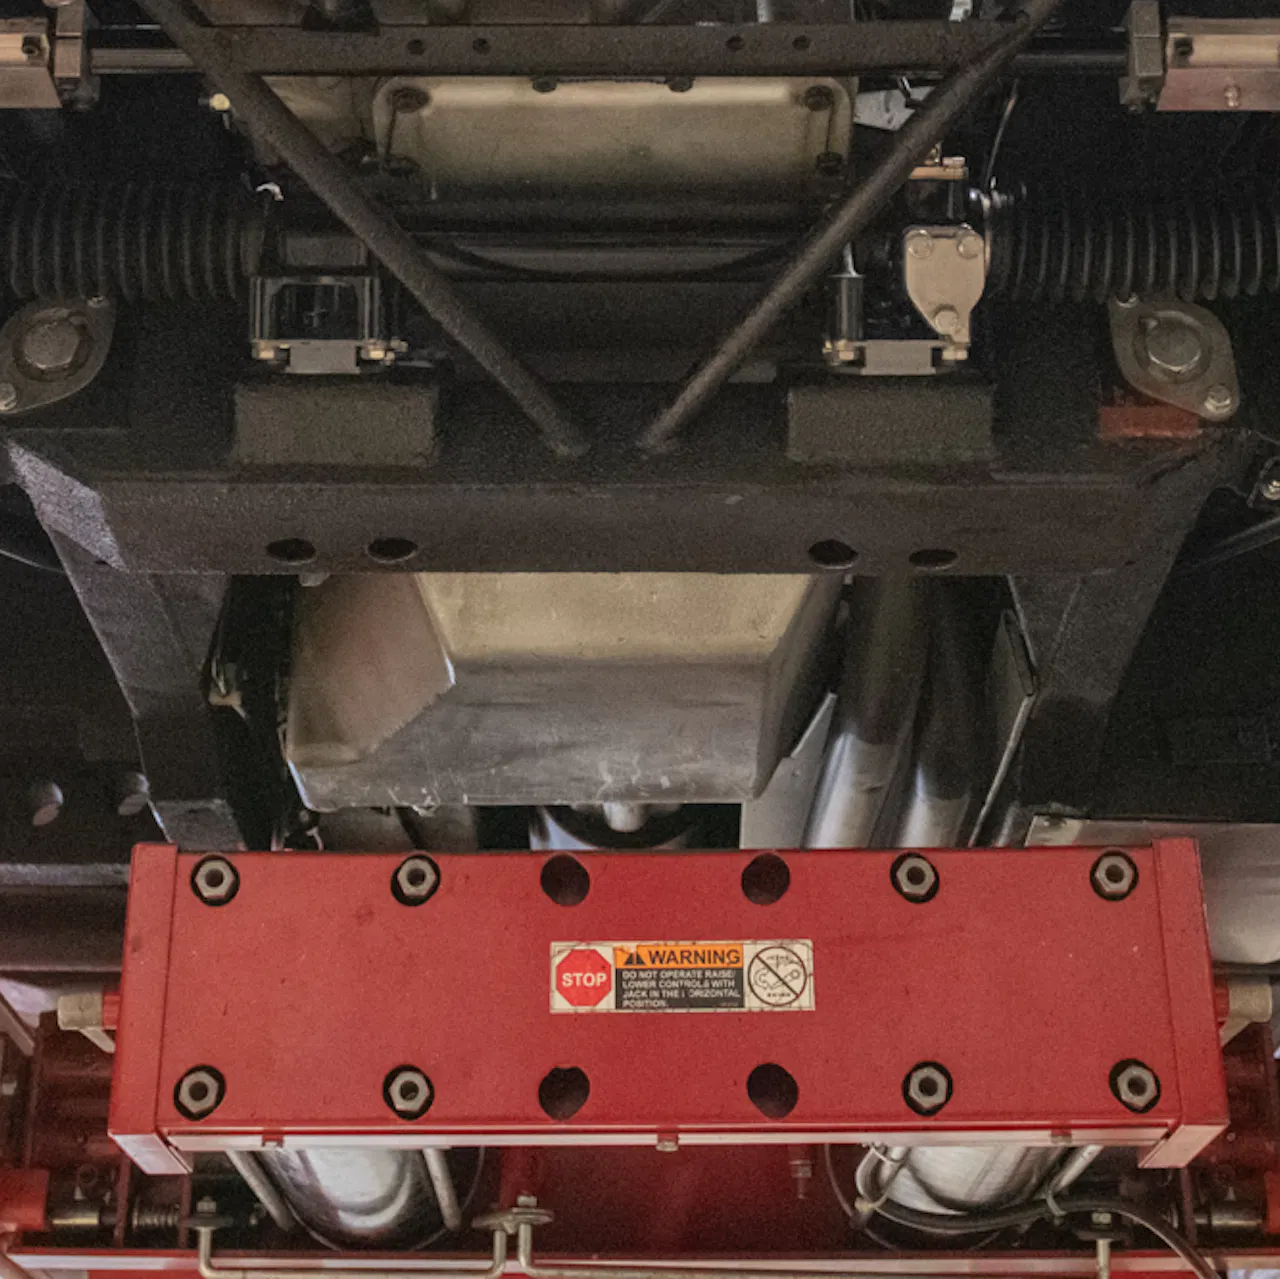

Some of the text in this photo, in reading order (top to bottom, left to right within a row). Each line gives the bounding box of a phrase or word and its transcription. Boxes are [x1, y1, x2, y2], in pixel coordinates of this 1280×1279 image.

[649, 949, 740, 965] WARNING
[622, 970, 637, 979] DO
[638, 970, 658, 979] NOT
[660, 970, 703, 978] OPERATE
[562, 972, 607, 987] STOP
[622, 979, 735, 988] LOWER CONTROLS WITH
[622, 989, 648, 998] JACK
[650, 989, 660, 998] IN
[662, 989, 679, 998] THE
